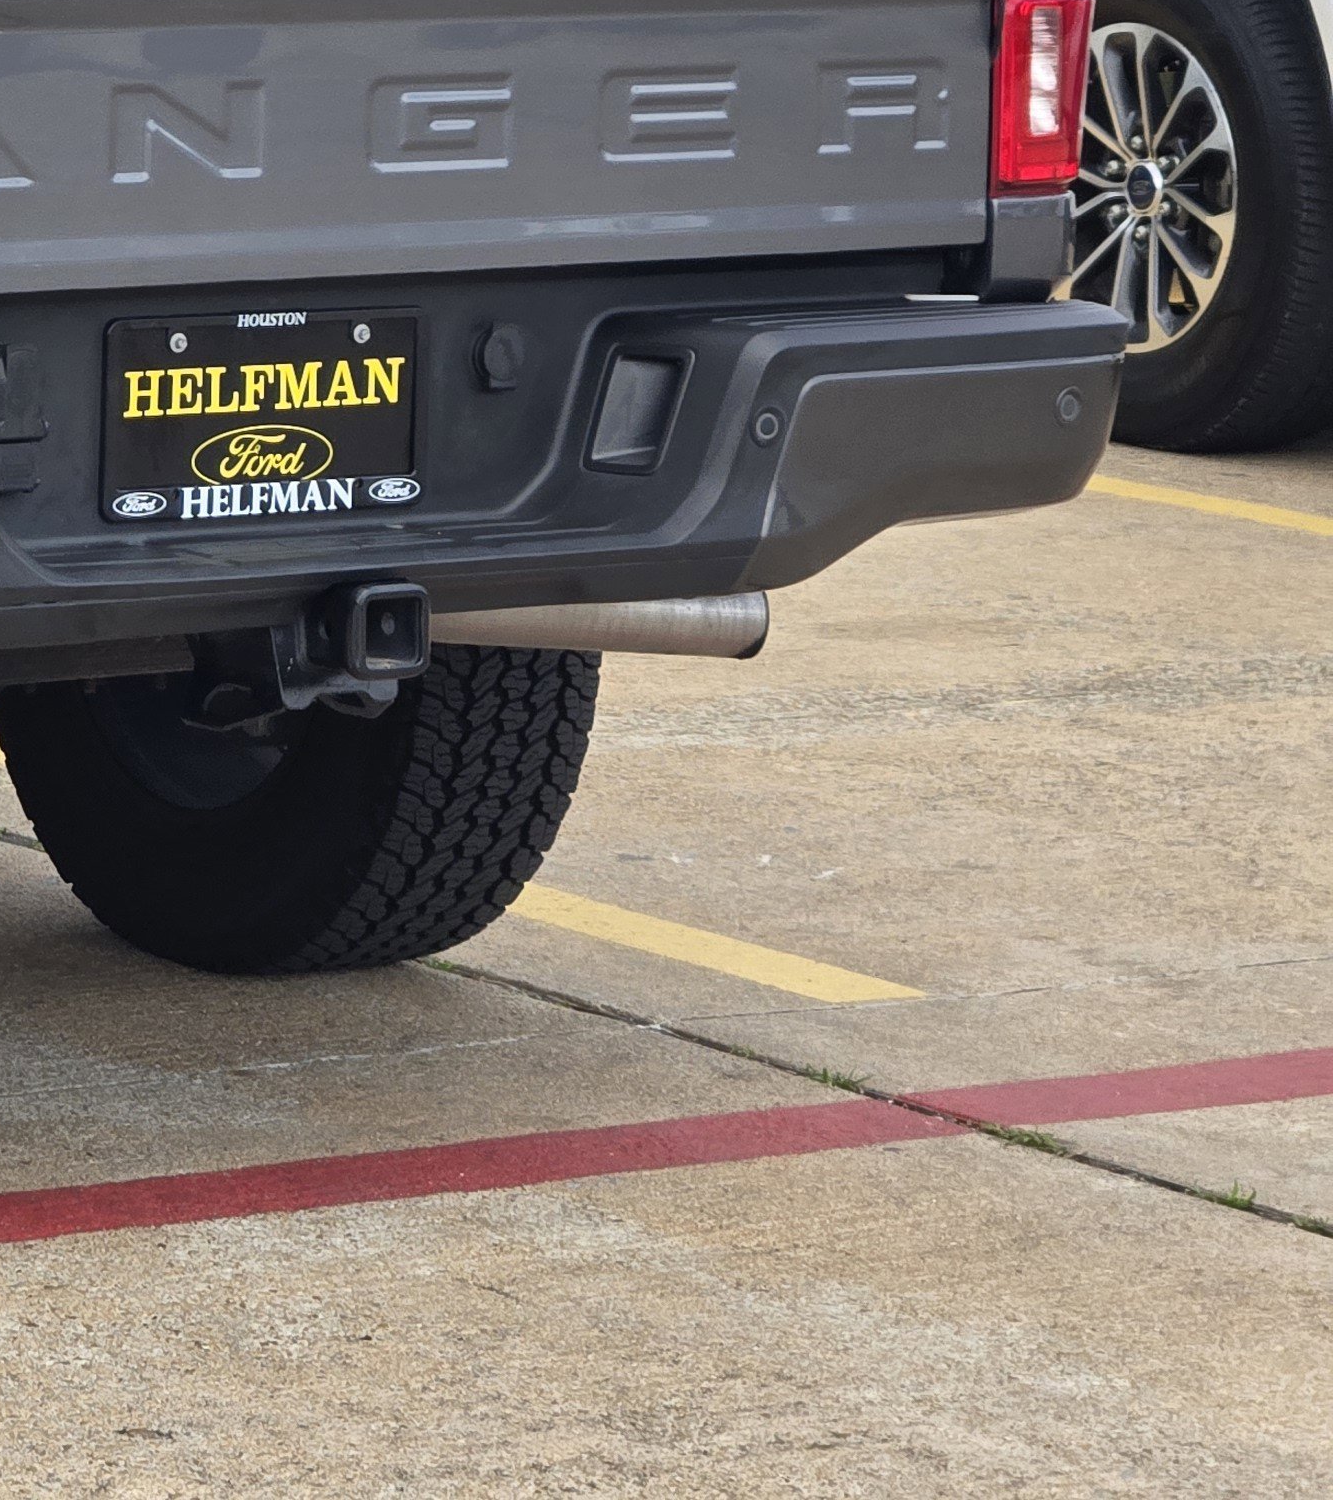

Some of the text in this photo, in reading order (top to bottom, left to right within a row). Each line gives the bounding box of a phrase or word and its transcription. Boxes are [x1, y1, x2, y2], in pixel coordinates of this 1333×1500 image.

[237, 311, 308, 329] HOUSTON
[123, 356, 406, 418] HELFMAN
[219, 433, 307, 479] Ford
[121, 477, 413, 520] Ford HELFMAN Ford
